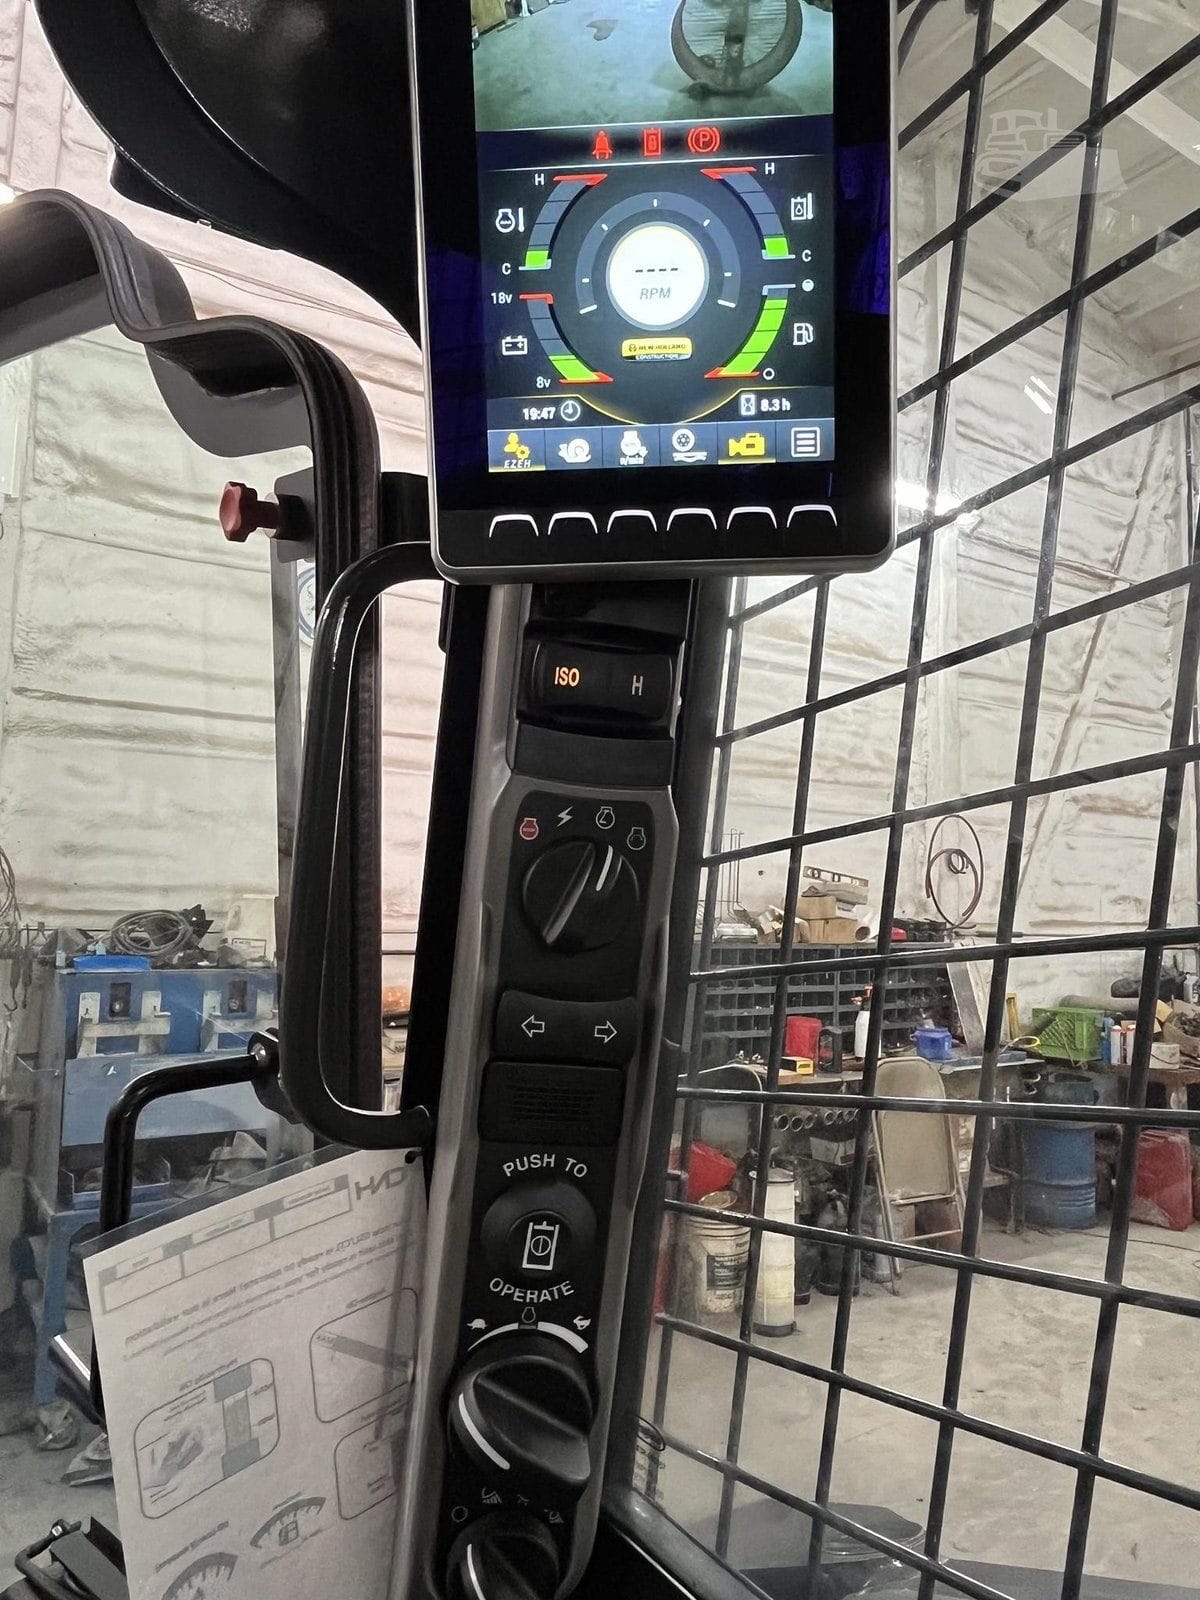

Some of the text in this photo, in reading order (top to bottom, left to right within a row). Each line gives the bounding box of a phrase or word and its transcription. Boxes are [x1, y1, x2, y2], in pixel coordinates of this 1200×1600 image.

[765, 162, 775, 174] H
[534, 173, 545, 186] H
[802, 250, 812, 262] C
[501, 263, 511, 275] C
[640, 287, 671, 300] RPM
[523, 406, 556, 421] 19:47
[504, 459, 532, 469] EZEH
[554, 666, 580, 687] ISO
[631, 675, 644, 696] H
[502, 1153, 588, 1178] PUSH TO
[489, 1277, 575, 1303] OPERATE
